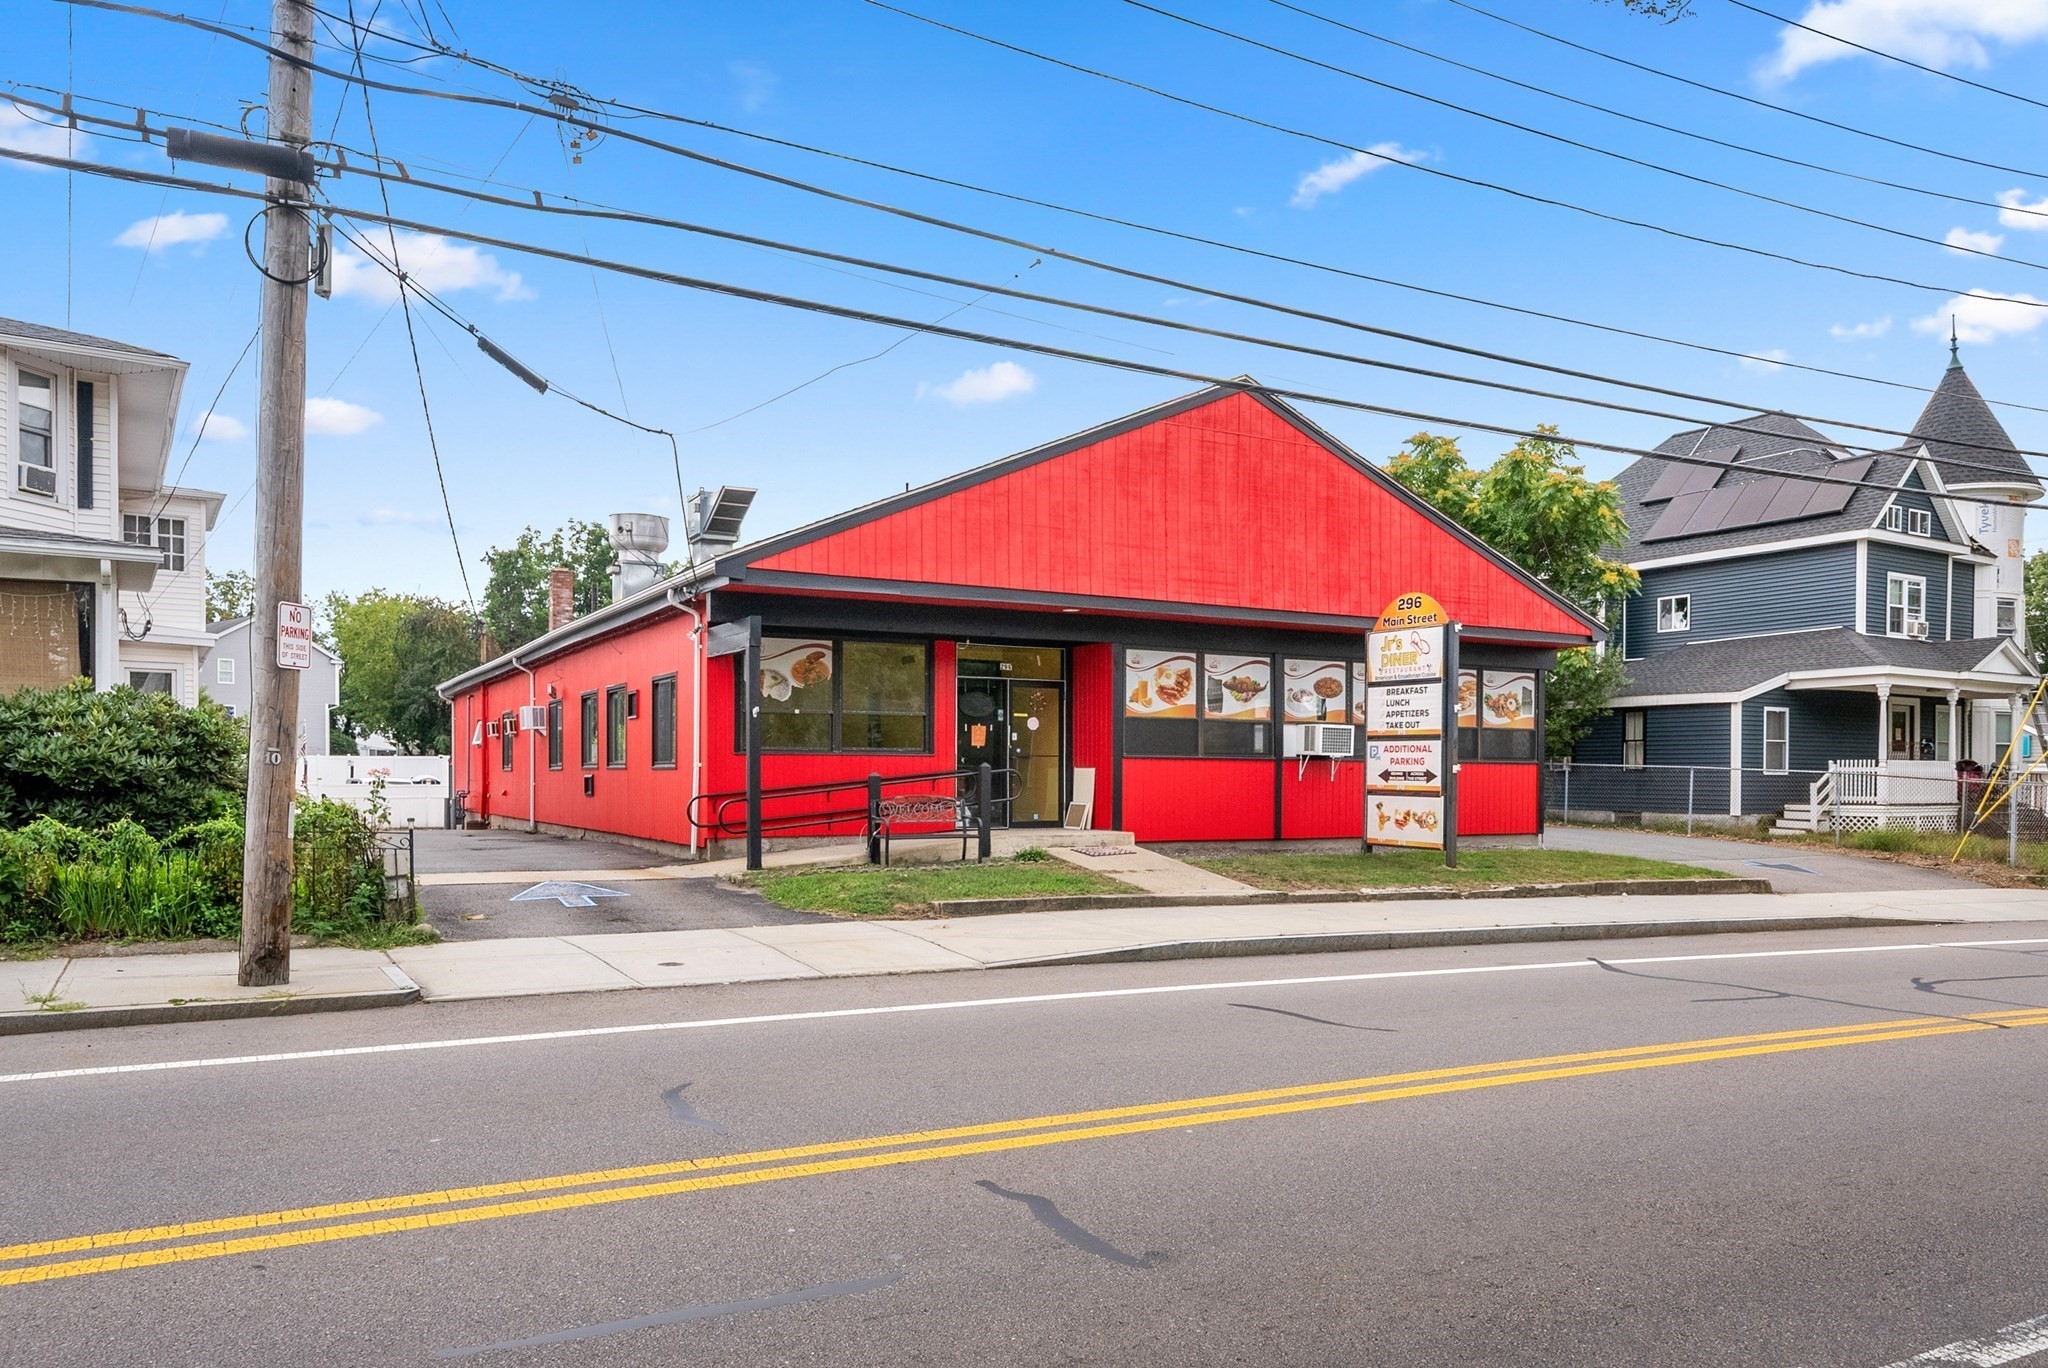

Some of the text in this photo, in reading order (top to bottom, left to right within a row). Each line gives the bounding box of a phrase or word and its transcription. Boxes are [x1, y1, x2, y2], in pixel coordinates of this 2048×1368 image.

[1398, 596, 1422, 610] 296
[289, 610, 302, 623] NO
[1382, 613, 1437, 627] Main Street
[280, 625, 309, 640] PARKING
[283, 642, 294, 650] THIS
[1380, 635, 1403, 652] Jr's
[290, 652, 307, 660] STREET
[1381, 651, 1418, 668] DINER
[1386, 686, 1428, 696] BREAKFAST
[1386, 699, 1410, 707] LUNCH
[1386, 709, 1429, 718] APPETIZERS
[1405, 721, 1420, 729] OUT
[1383, 745, 1432, 753] ADDITIONAL
[264, 753, 281, 765] 10
[1390, 757, 1425, 766] PARKING
[889, 802, 946, 815] WELCOME
